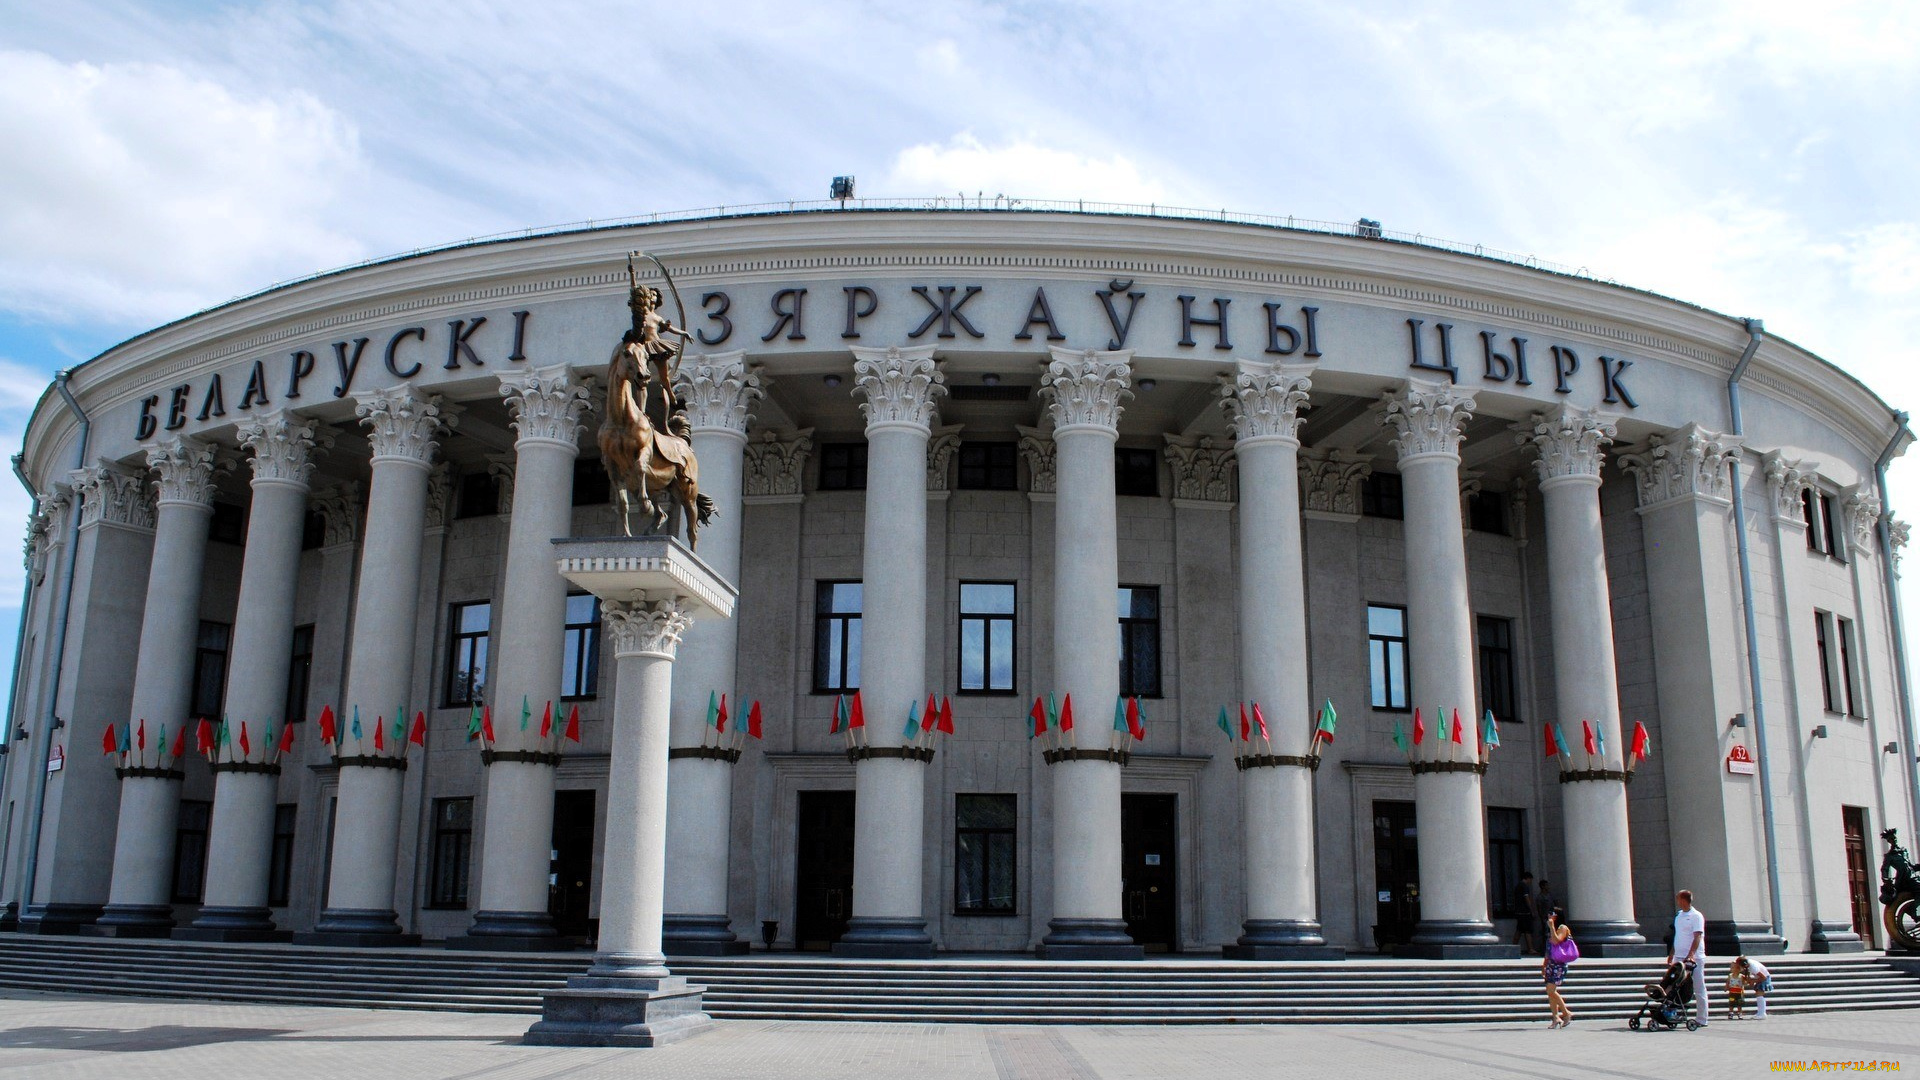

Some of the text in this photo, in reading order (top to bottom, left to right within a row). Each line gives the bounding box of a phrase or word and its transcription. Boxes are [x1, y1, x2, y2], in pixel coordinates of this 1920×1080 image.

[135, 279, 1638, 440] БЕЛАРУСКІ ЗЯРЖАЎНЫ ЦЫРК
[1736, 747, 1746, 760] 32
